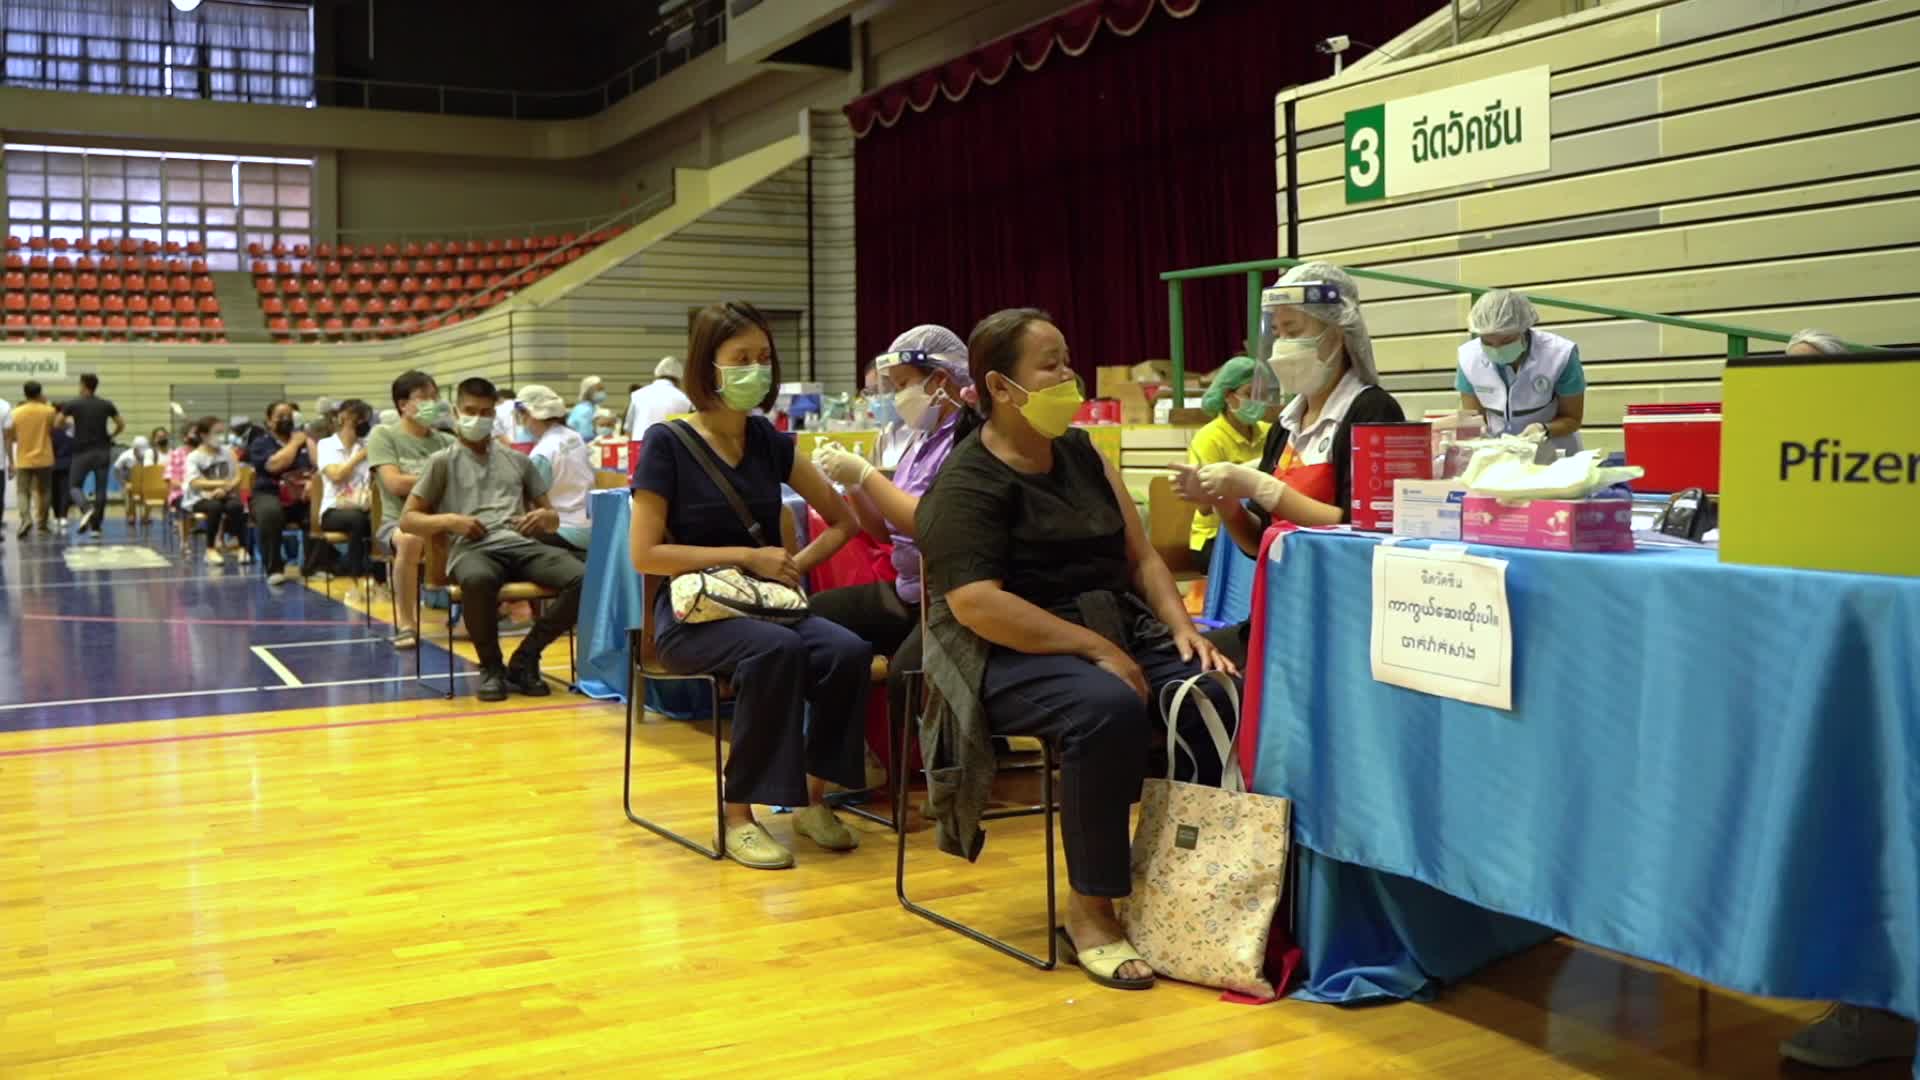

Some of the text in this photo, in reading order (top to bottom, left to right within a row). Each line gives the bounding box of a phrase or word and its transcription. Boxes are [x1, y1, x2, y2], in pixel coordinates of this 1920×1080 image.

[1350, 99, 1522, 188] 3 ฉีดวัคซีน
[1779, 438, 1920, 485] Pfizer
